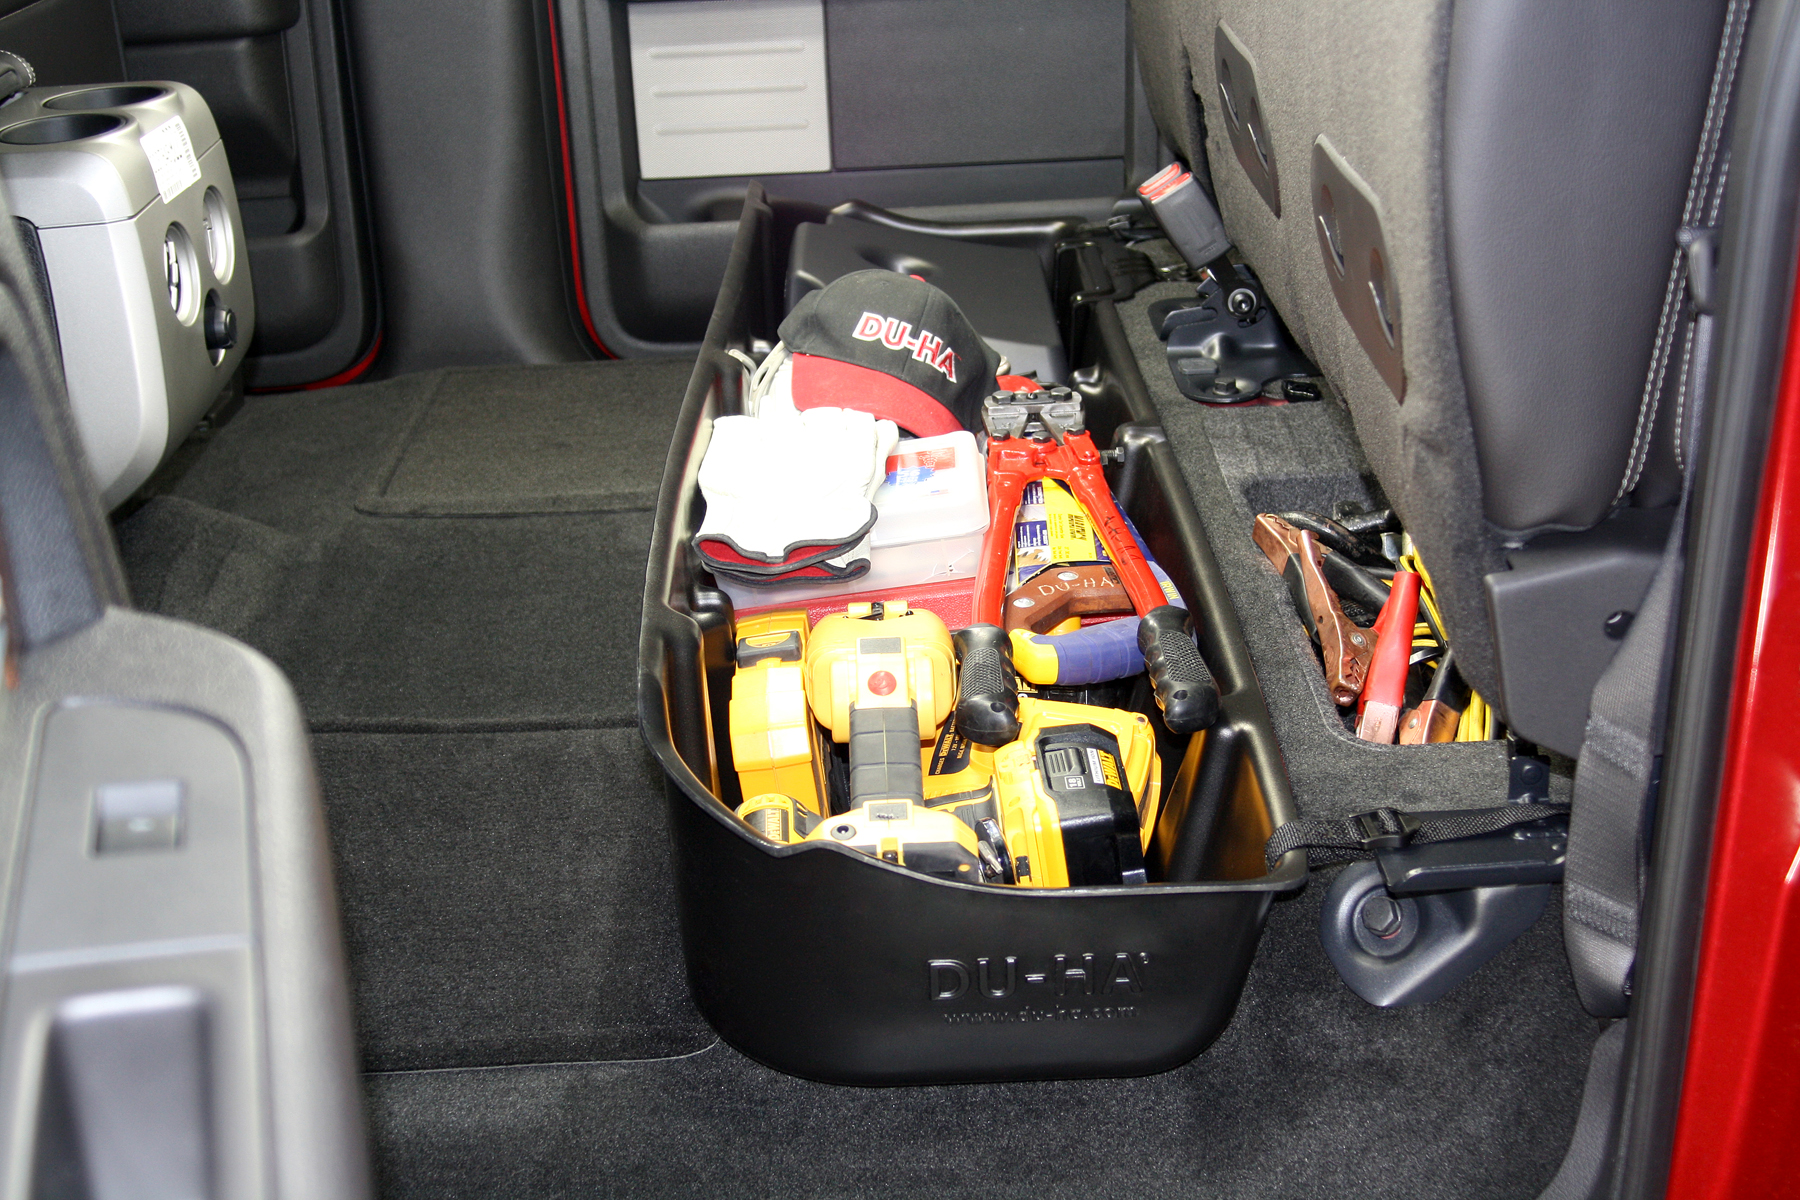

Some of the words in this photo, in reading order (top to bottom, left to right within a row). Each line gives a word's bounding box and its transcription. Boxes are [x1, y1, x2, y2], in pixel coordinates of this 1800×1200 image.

[852, 312, 957, 383] DU-HA
[1038, 577, 1115, 596] DU-HA
[1160, 581, 1179, 600] IRWIN
[928, 952, 1143, 1000] DU-HA
[944, 1004, 1140, 1025] www.du-ha.com
